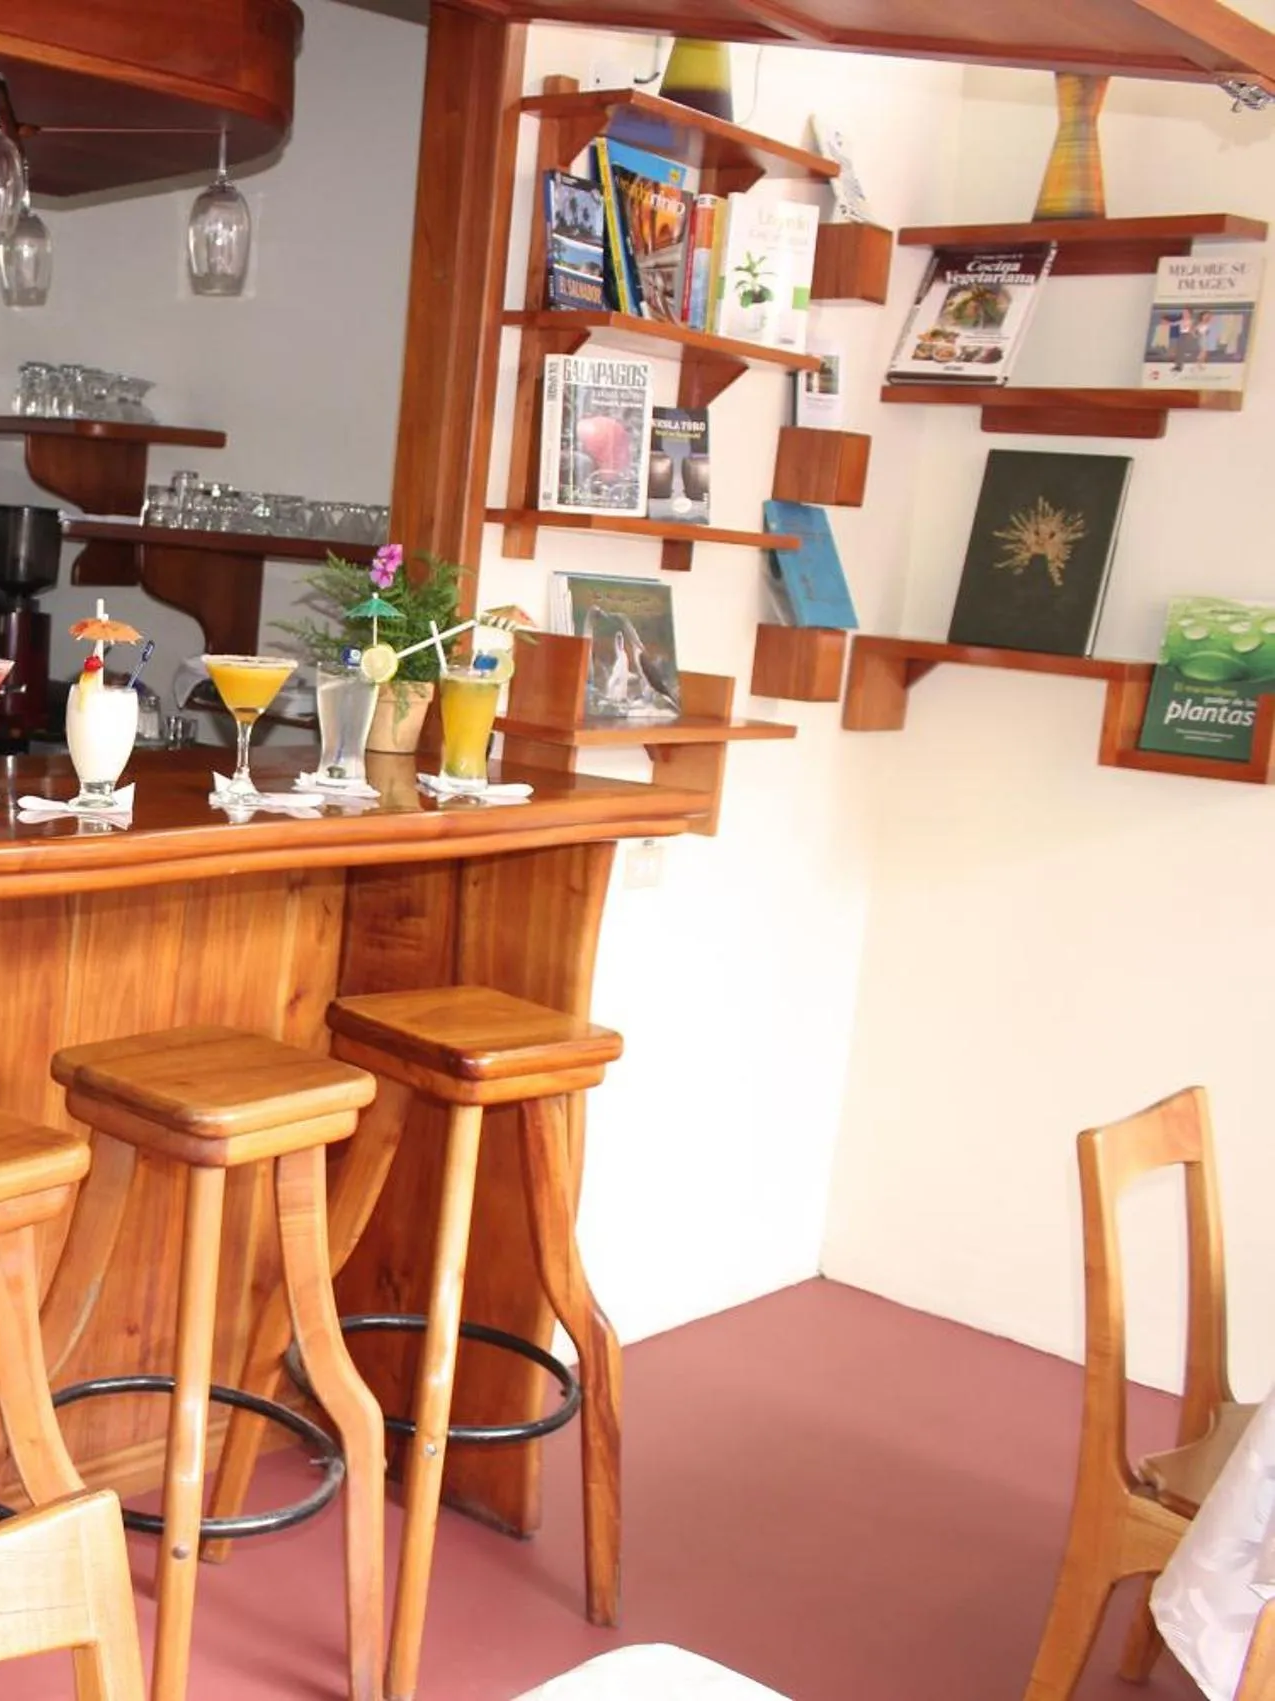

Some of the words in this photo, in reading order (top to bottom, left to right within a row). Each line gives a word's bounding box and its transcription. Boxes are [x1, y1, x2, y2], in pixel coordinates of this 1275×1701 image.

[966, 260, 1022, 274] Cocina
[1169, 264, 1223, 276] MEJORE
[946, 270, 1036, 285] Vegetariana
[1178, 278, 1236, 290] IMAGEN
[564, 358, 649, 387] GALAPAGOS
[1164, 698, 1256, 727] plantas
